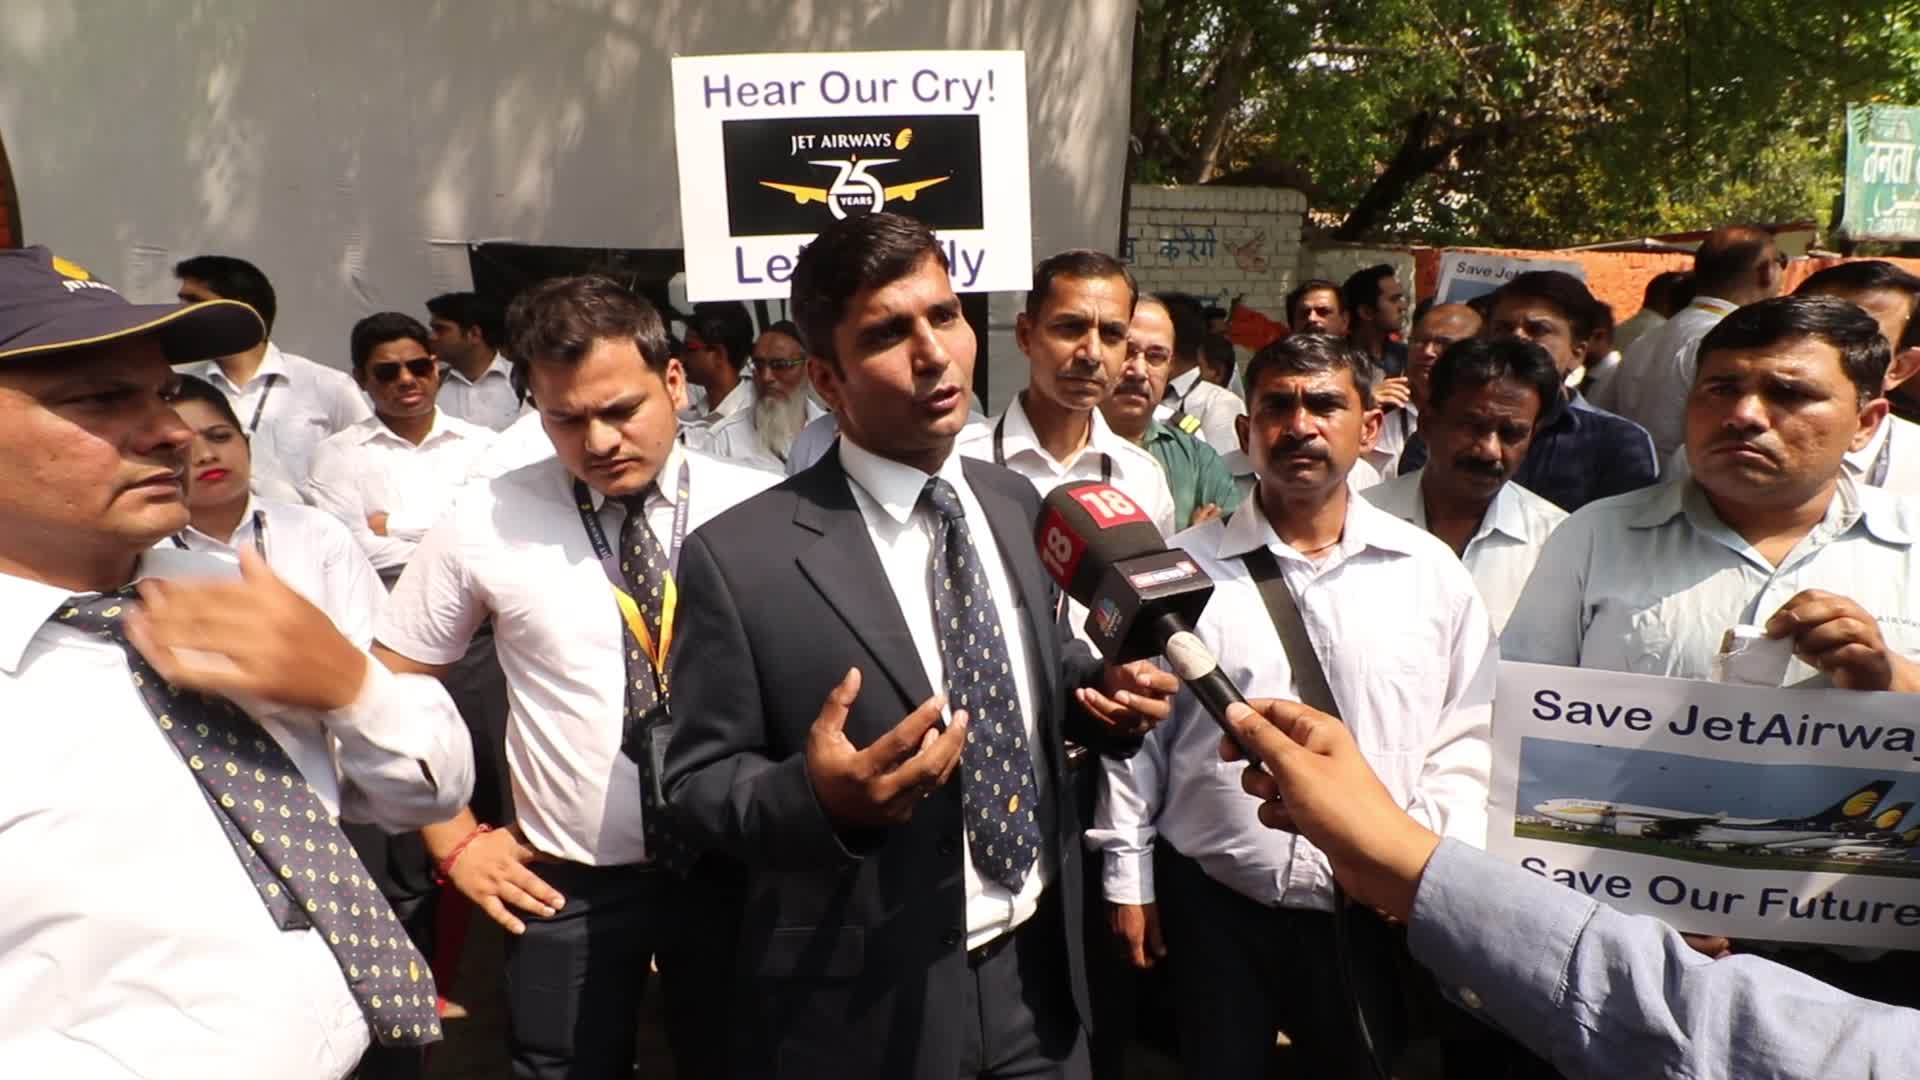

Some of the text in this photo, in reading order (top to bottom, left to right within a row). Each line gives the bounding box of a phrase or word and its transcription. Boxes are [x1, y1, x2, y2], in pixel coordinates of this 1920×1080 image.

[703, 69, 995, 111] Hear Our Cry!
[791, 133, 891, 156] JET AIRWAYS
[840, 196, 872, 206] YEARS
[735, 239, 985, 287] Le ly
[1456, 262, 1492, 278] Save
[1080, 490, 1136, 519] 18
[1043, 527, 1072, 577] 18
[1532, 690, 1920, 761] Save JetAirwa
[1648, 875, 1744, 915] Our
[1757, 887, 1920, 927] Future
